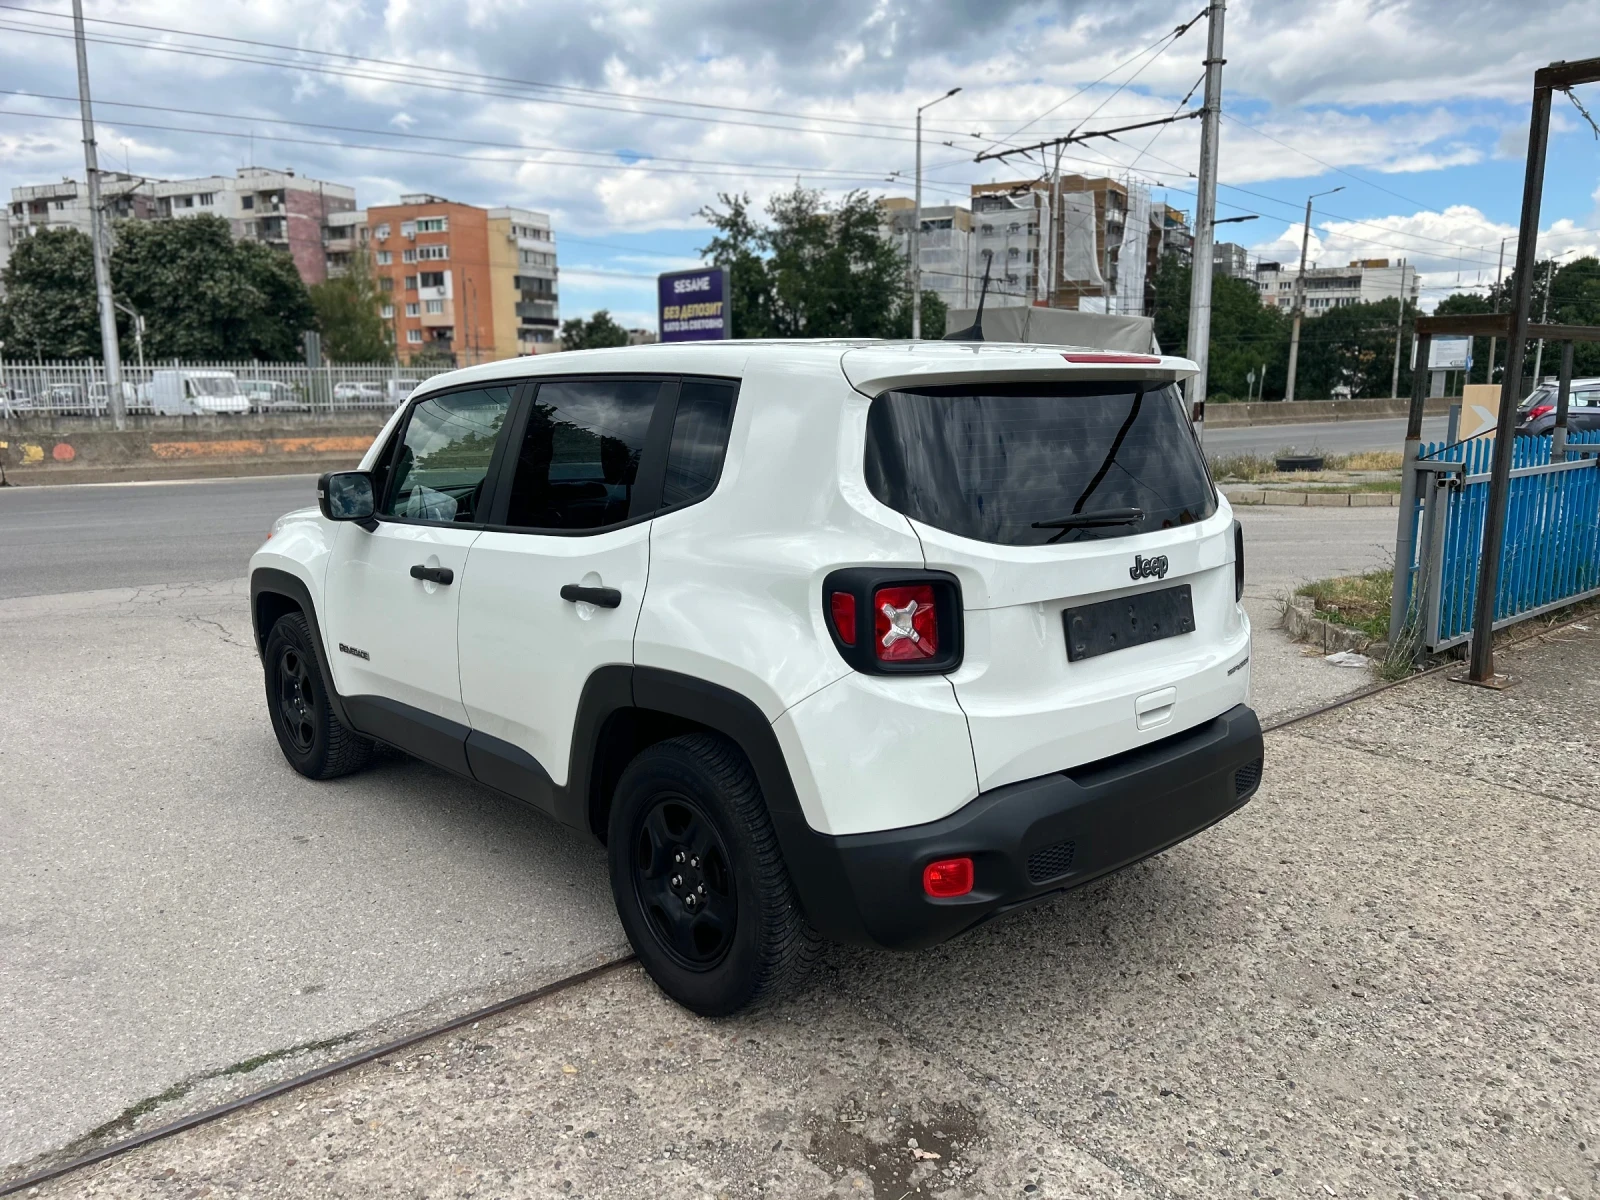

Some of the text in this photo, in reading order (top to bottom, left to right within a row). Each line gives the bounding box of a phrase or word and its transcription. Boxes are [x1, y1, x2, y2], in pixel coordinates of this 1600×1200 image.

[673, 276, 711, 294] SESAME
[663, 301, 723, 320] БЕЗ ДЕПОЗИТ
[1129, 554, 1169, 580] Jeep
